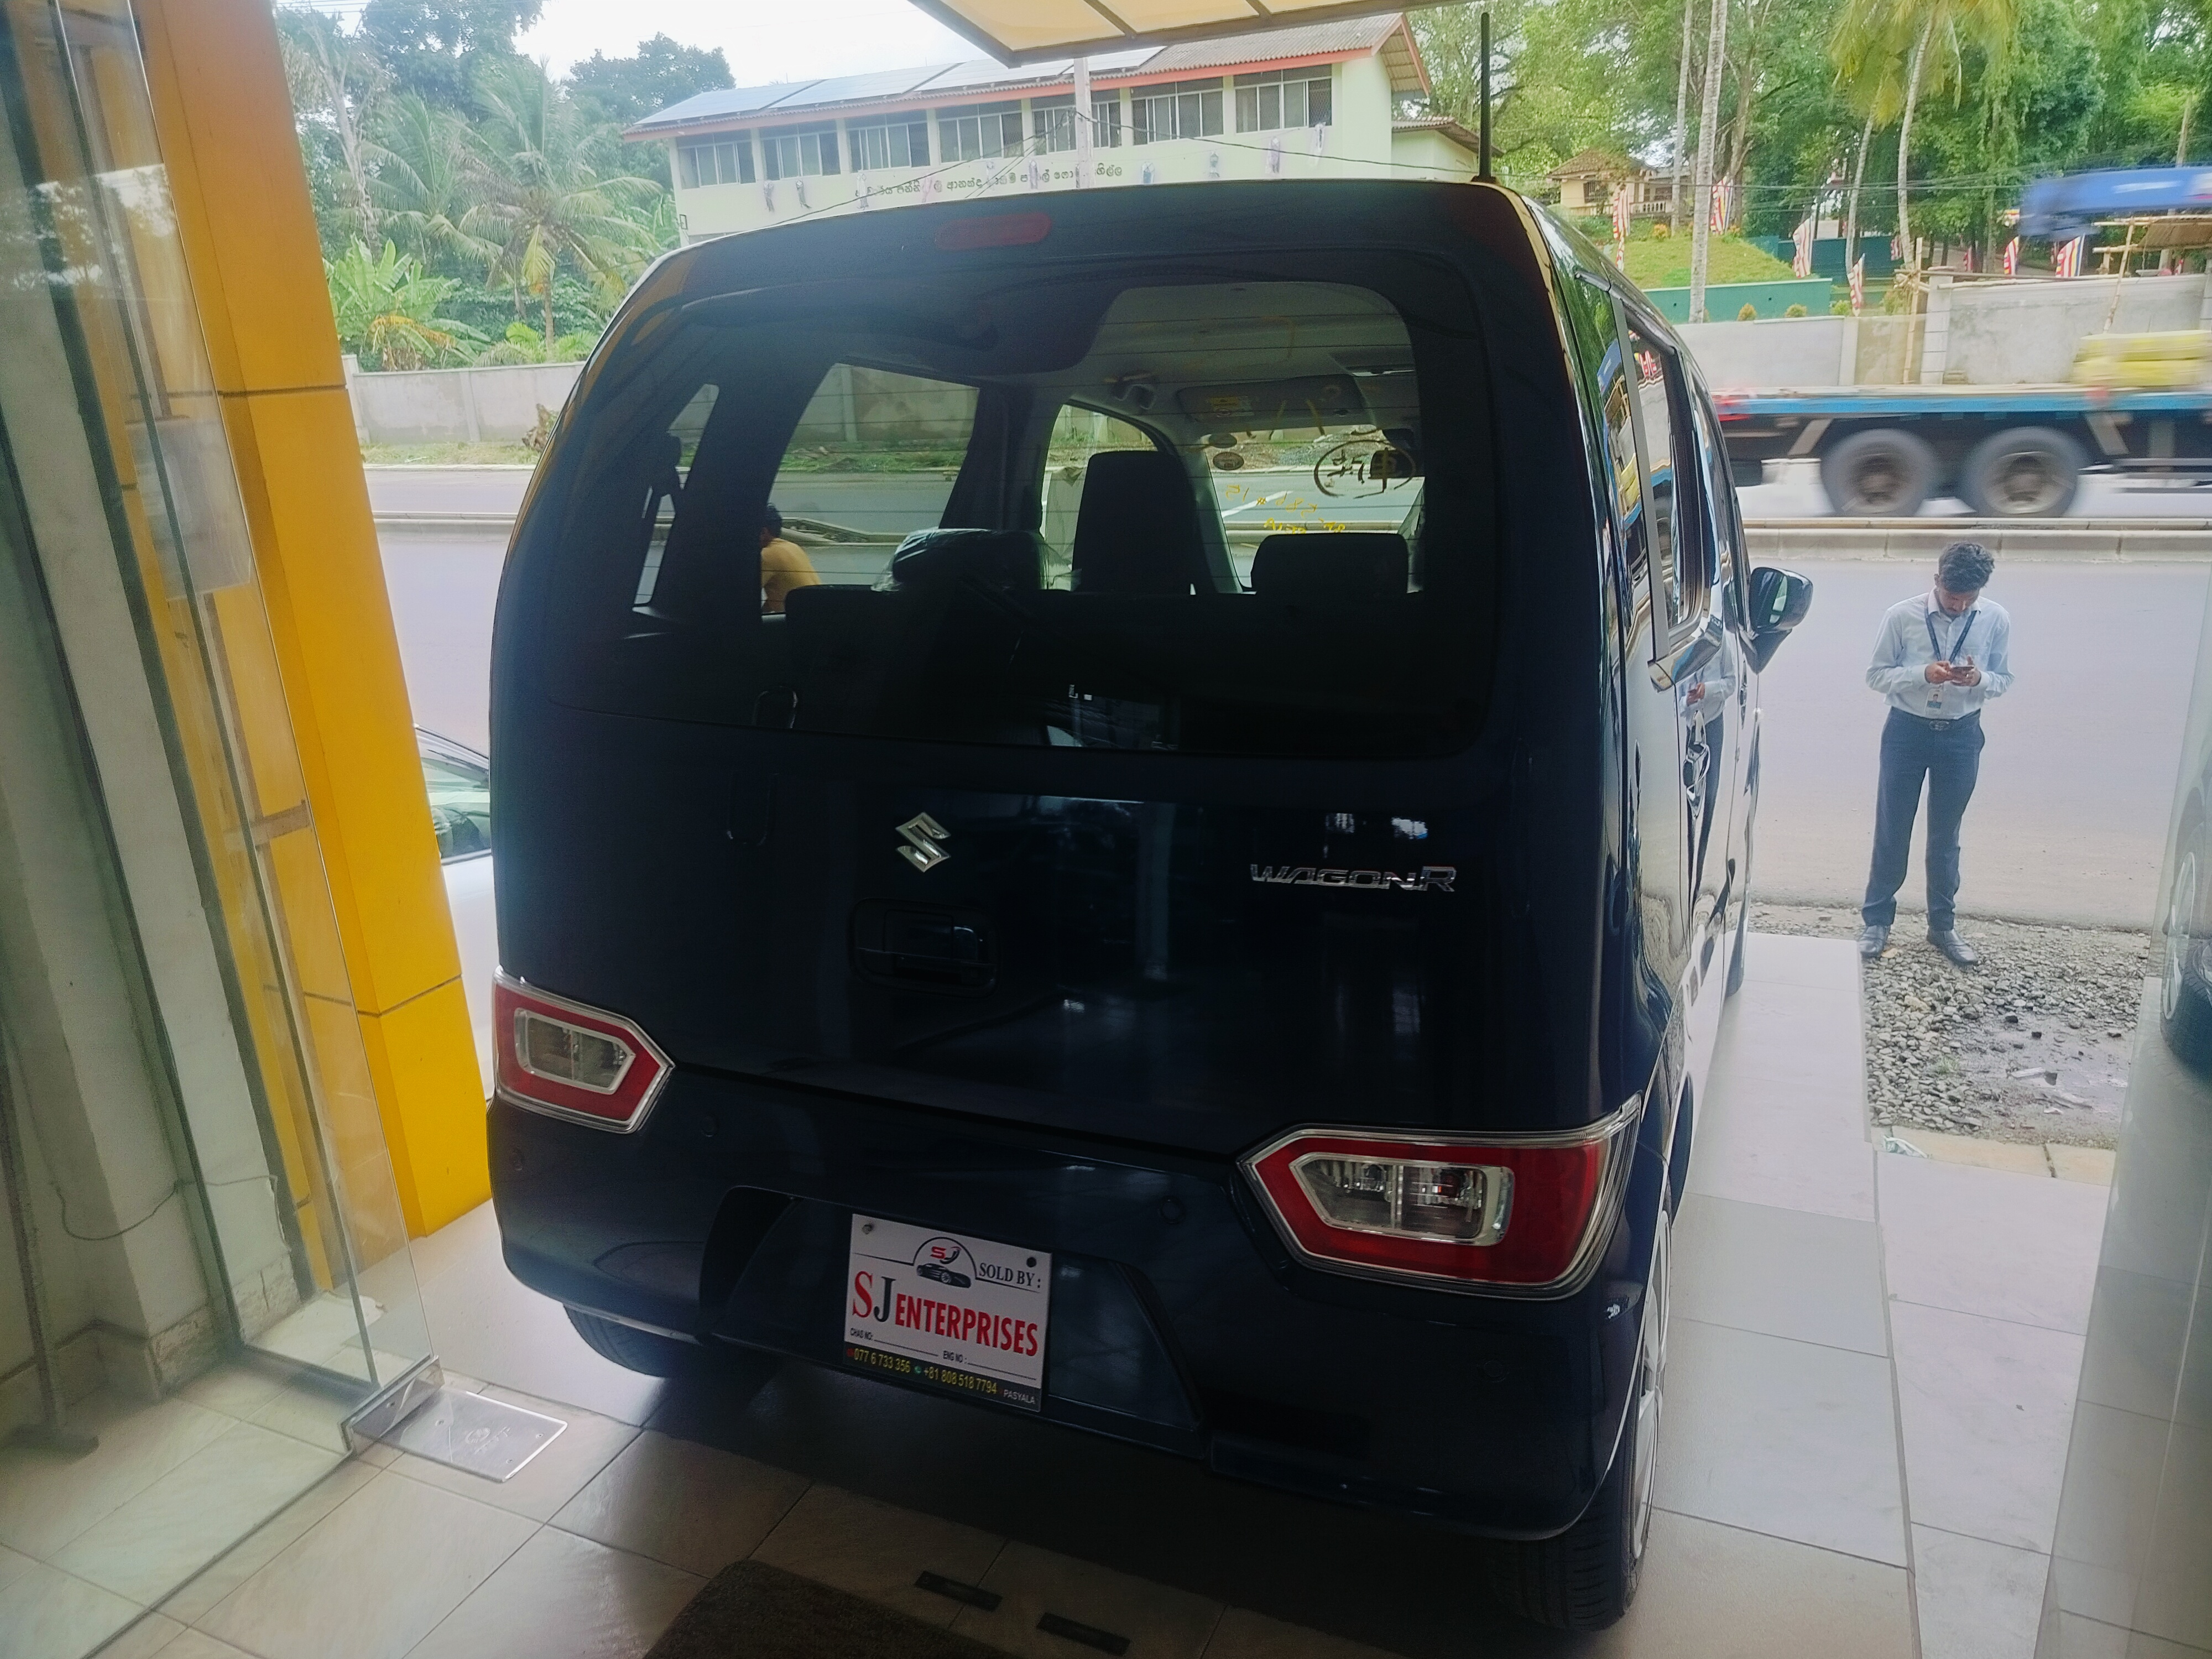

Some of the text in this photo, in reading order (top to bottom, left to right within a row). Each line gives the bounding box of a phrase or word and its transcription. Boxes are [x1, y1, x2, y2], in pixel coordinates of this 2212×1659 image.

[979, 1262, 1013, 1282] SOLD
[852, 1270, 1038, 1357] SJ ENTERPRISES
[854, 1348, 869, 1362] 077
[870, 1352, 877, 1364] 6
[878, 1354, 894, 1369] 733
[924, 1366, 939, 1380] +81
[958, 1374, 974, 1389] 518
[975, 1378, 998, 1394] 7794
[1003, 1389, 1036, 1405] PASYALA
